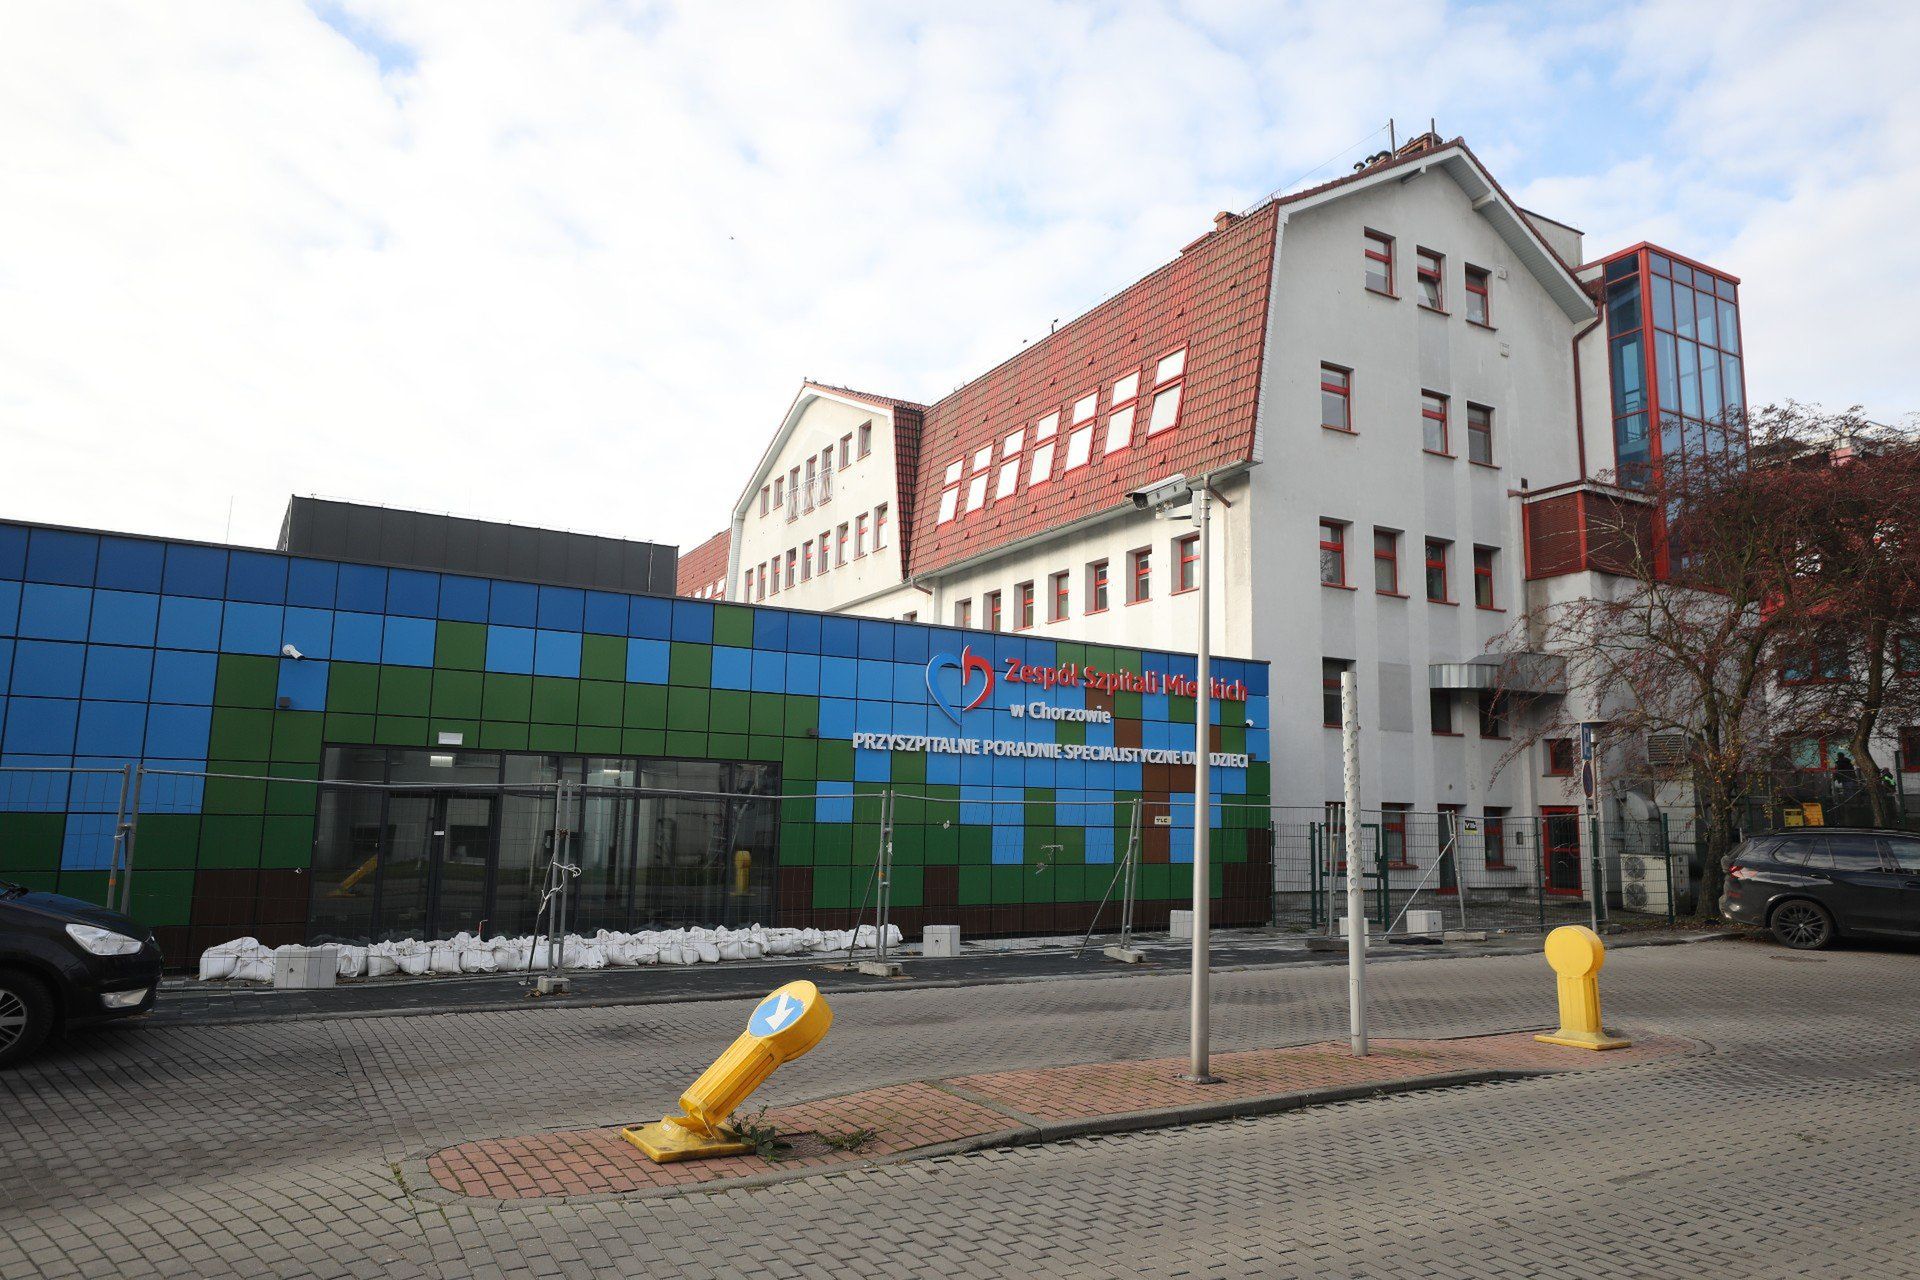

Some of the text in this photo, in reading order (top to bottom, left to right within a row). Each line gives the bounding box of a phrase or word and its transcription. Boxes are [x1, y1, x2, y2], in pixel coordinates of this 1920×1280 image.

[1005, 657, 1248, 702] Zespół Szpitali Miekich
[1009, 701, 1111, 724] w Chorzowie
[852, 732, 980, 755] PRZYSZPITALNE
[982, 739, 1062, 759] PORADNIE
[1063, 744, 1182, 765] SPECJALISTYCZNE
[1209, 752, 1249, 768] DZIECI
